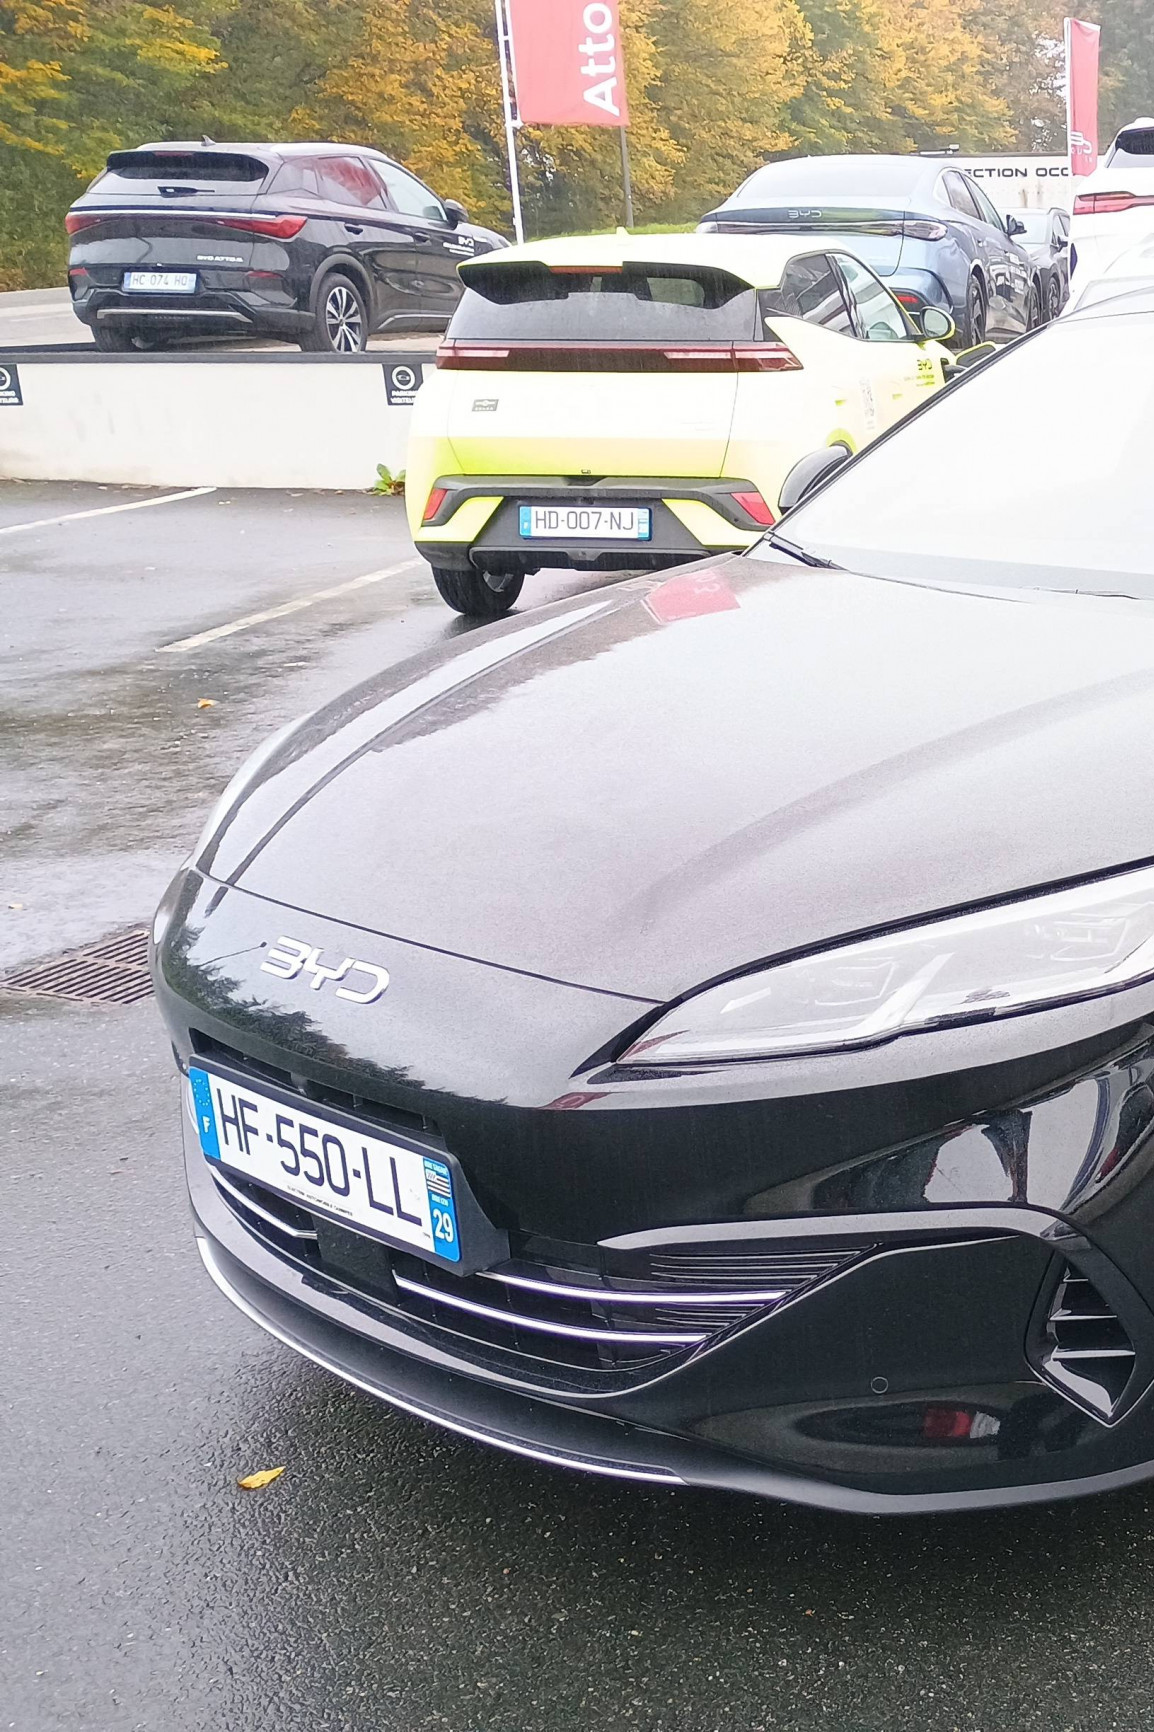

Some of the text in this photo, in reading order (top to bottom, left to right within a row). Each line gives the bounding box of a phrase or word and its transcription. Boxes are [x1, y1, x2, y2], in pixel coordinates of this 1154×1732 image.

[578, 2, 620, 117] Atto
[787, 209, 822, 219] BYD
[534, 510, 634, 531] HD-007-NJ
[260, 936, 391, 1004] BYD
[202, 1115, 211, 1134] F
[217, 1088, 423, 1227] HF-550-LL
[432, 1208, 454, 1243] 29
